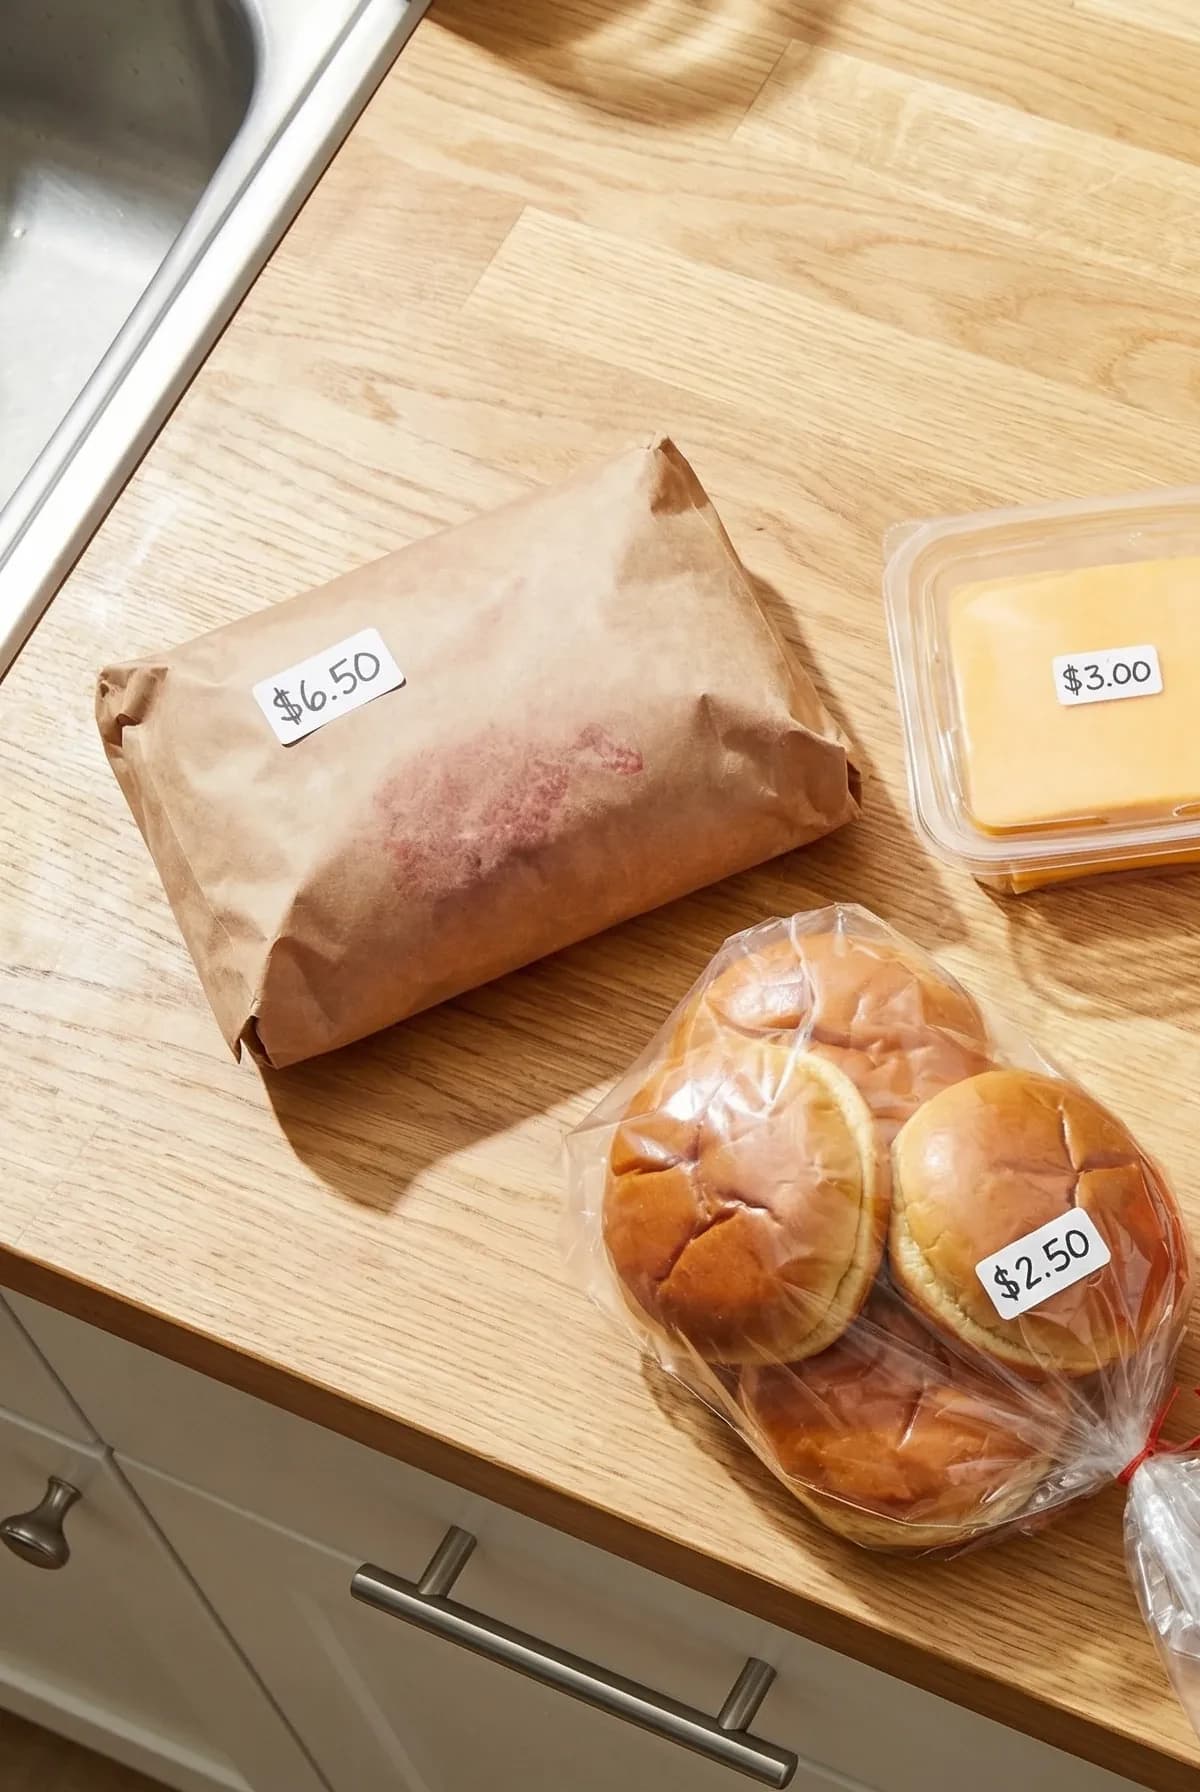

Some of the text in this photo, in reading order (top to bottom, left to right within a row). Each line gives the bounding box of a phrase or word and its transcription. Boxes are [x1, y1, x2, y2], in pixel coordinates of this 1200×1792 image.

[272, 650, 382, 726] $6.50
[1062, 660, 1151, 696] $3.00
[992, 1228, 1091, 1302] $2.50
